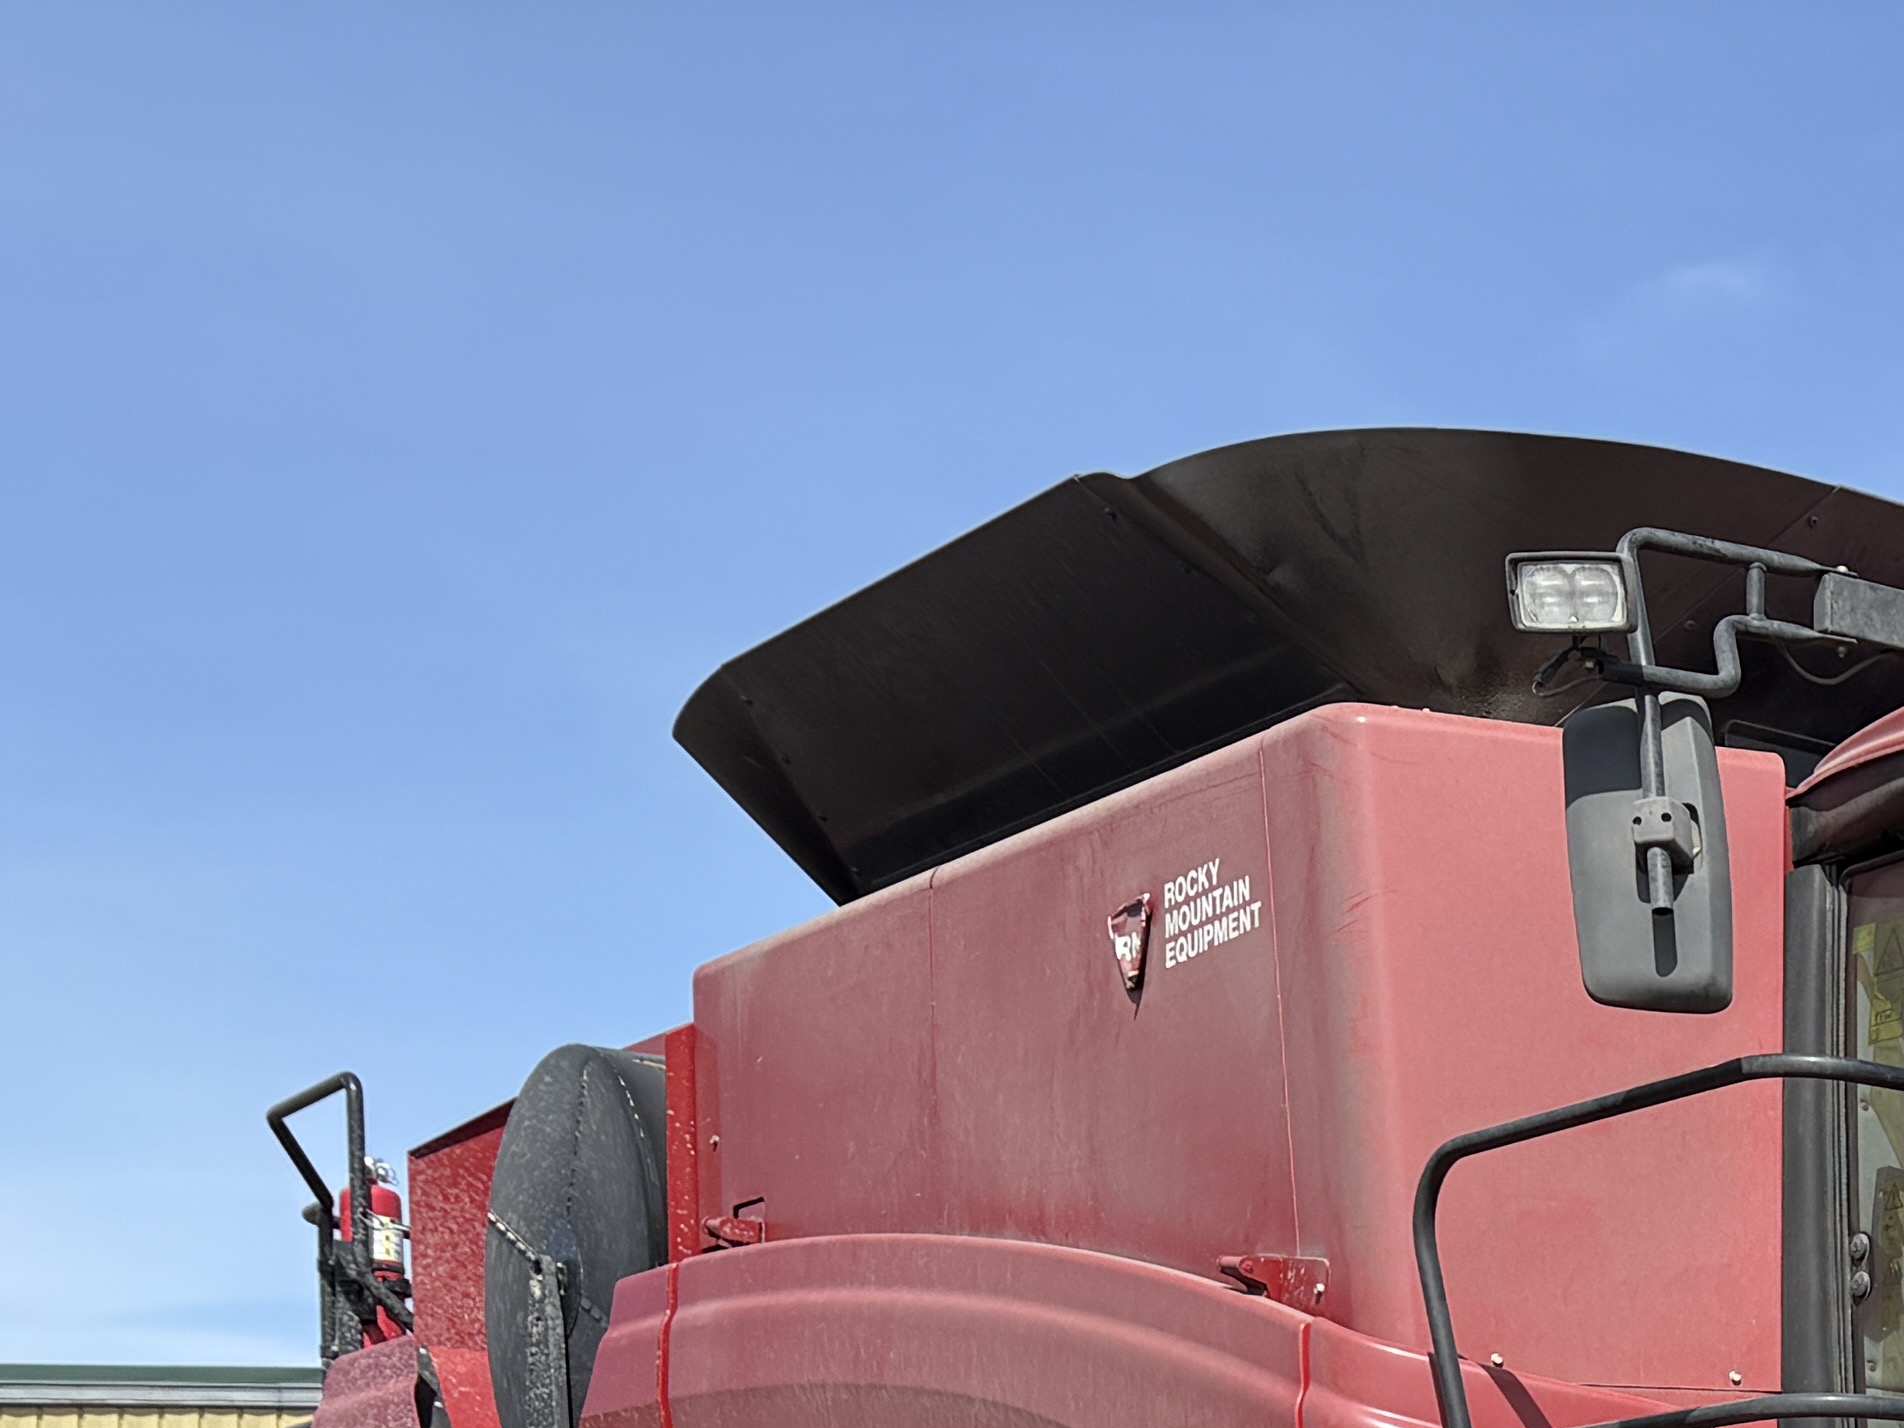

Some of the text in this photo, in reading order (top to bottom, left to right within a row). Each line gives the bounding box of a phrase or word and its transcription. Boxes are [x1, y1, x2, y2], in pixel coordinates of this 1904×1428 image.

[1164, 858, 1220, 908] ROCKY
[1164, 876, 1250, 938] MOUNTAIN
[1165, 901, 1262, 969] EQUIPMENT
